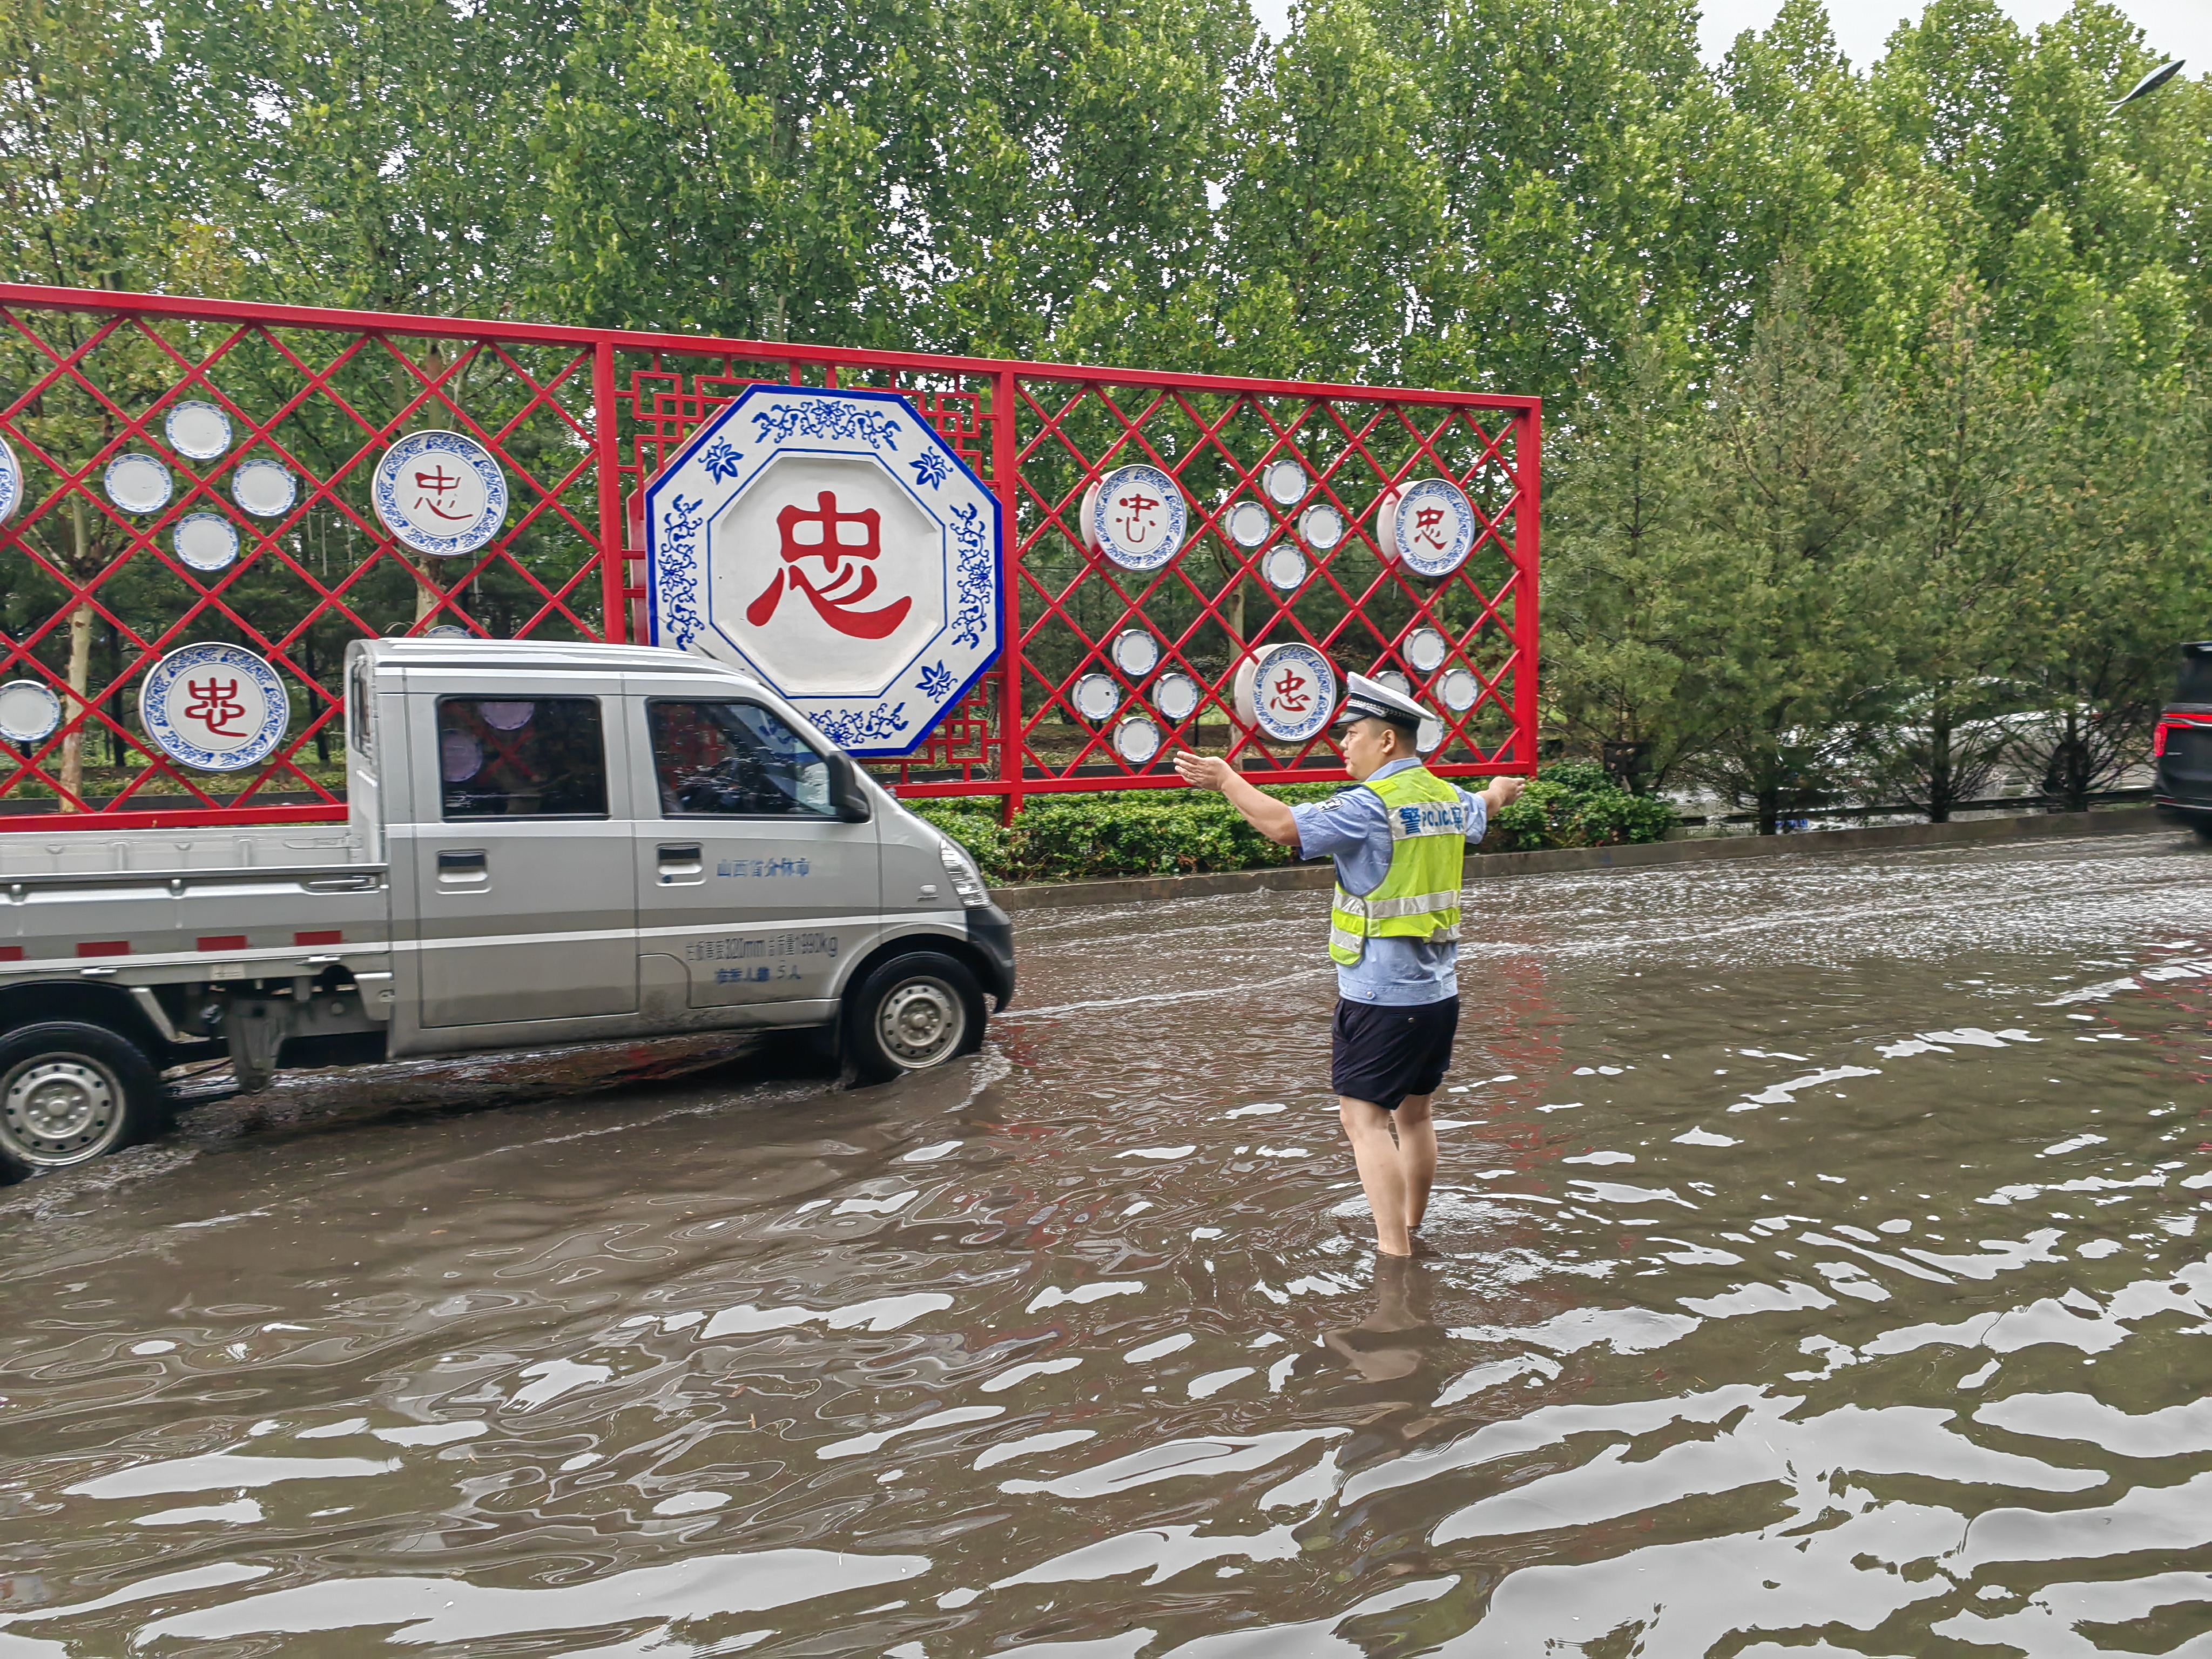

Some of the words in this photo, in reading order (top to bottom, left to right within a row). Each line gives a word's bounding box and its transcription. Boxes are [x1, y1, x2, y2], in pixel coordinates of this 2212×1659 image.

[415, 464, 473, 521] 忠
[1115, 493, 1159, 543] 忠
[1414, 506, 1448, 551] 忠
[745, 490, 913, 640] 忠
[1269, 668, 1311, 713] 忠
[1422, 810, 1454, 827] POLIC
